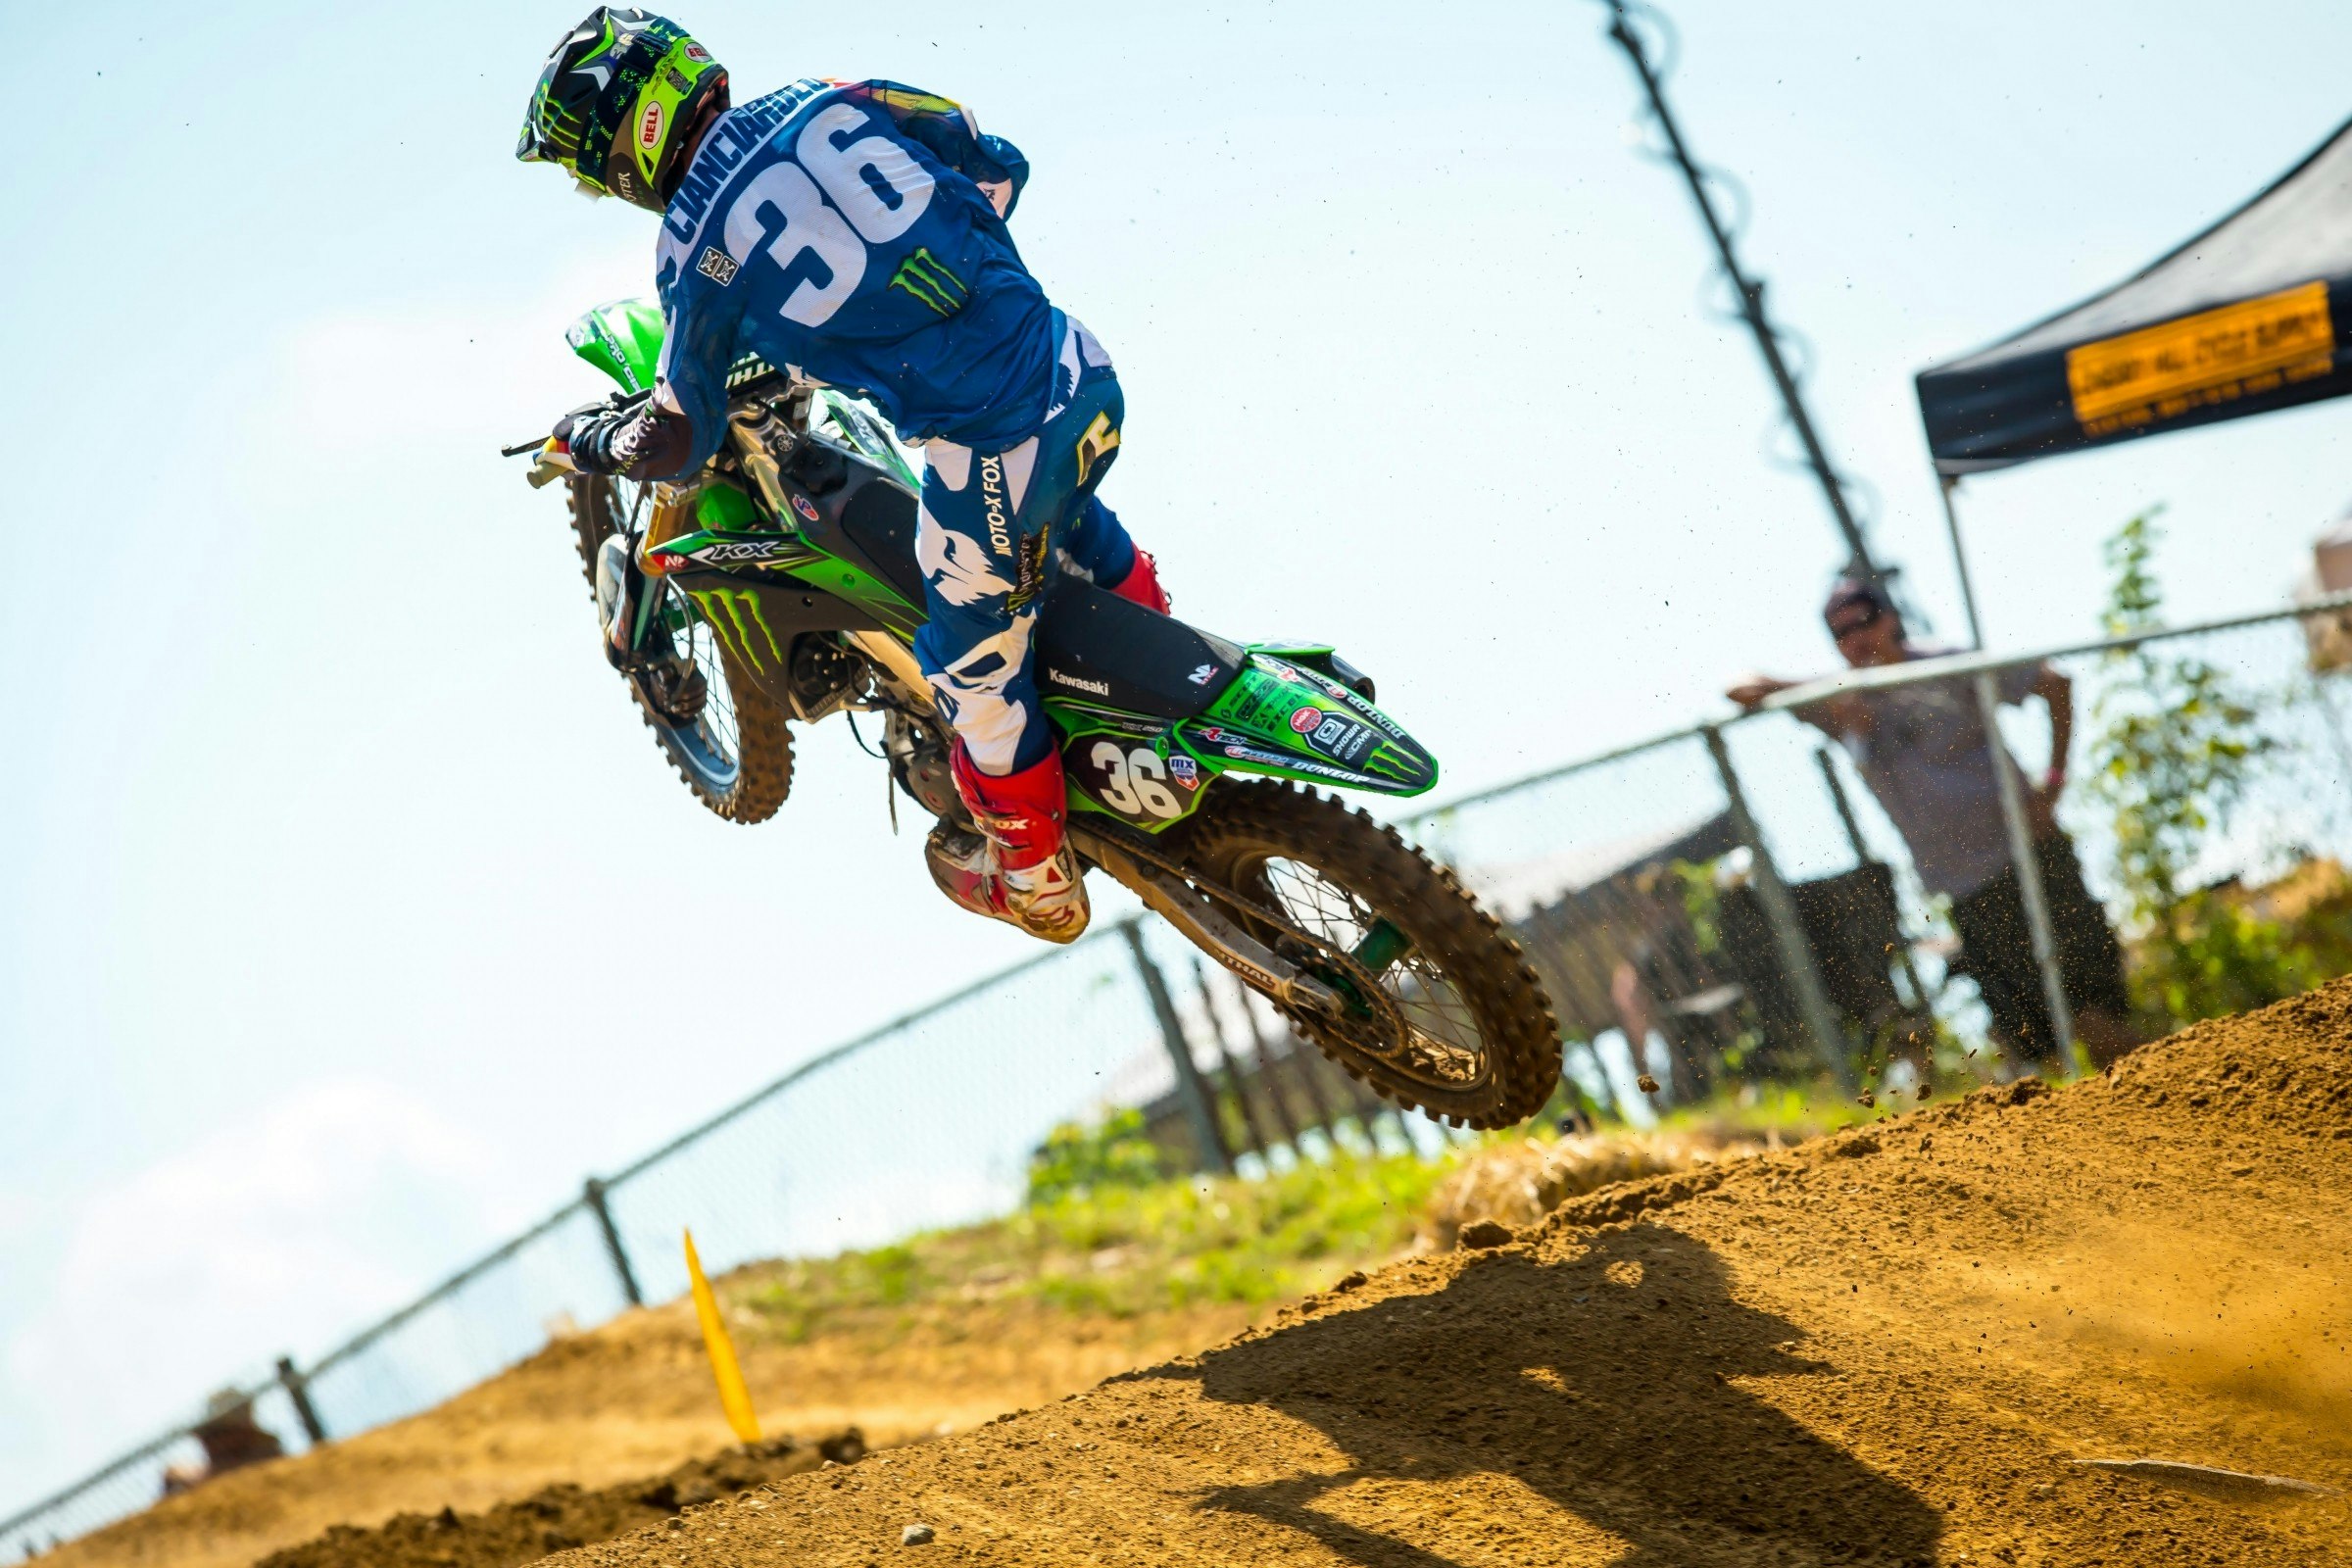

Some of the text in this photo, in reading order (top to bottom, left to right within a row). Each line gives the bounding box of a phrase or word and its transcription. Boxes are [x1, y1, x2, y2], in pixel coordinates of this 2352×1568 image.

[643, 108, 659, 143] BELL
[724, 103, 935, 327] 36
[980, 456, 1002, 494] FOX
[709, 540, 781, 561] KX
[1049, 667, 1109, 697] Kawasaki
[1347, 694, 1406, 739] DUNLOP
[1333, 723, 1361, 757] SHOWA
[1090, 741, 1183, 819] 36
[1292, 761, 1370, 783] DUNLOP
[993, 818, 1029, 830] OX
